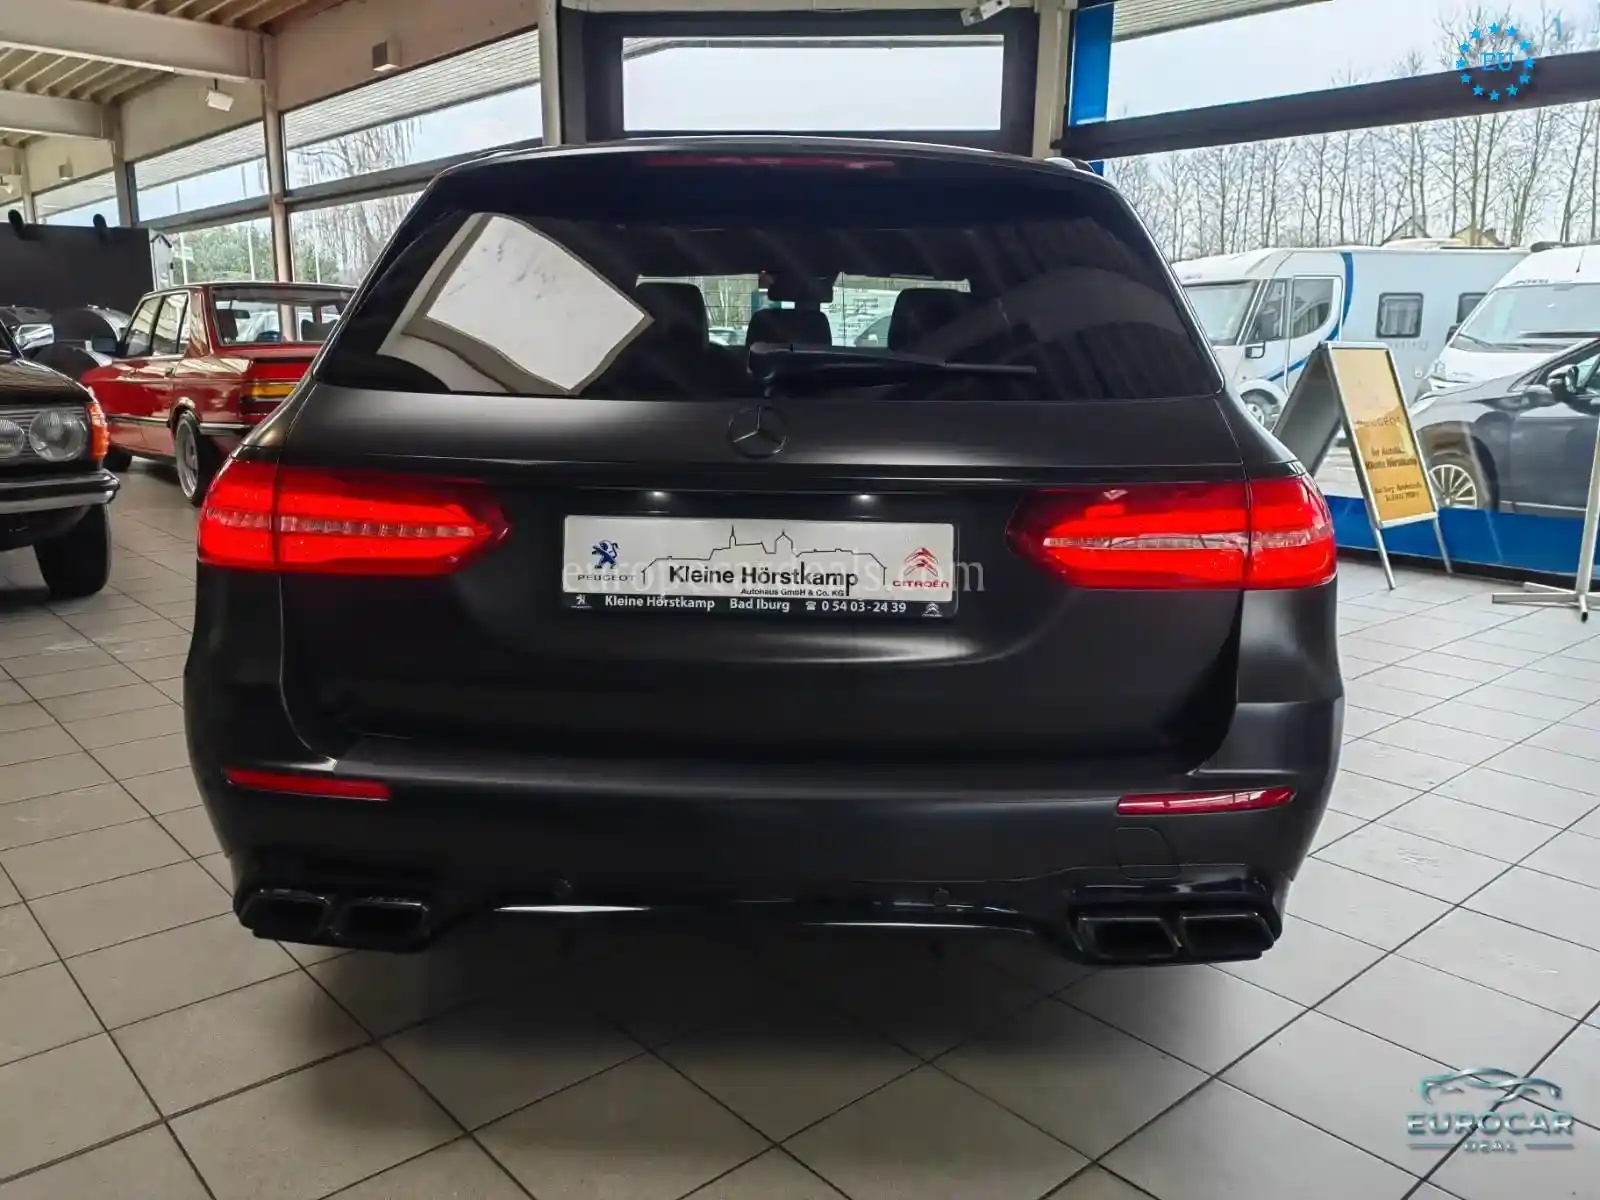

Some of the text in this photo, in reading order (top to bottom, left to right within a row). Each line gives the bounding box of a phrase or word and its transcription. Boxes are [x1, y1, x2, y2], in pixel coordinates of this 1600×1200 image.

[577, 574, 635, 582] PEUGEOT
[669, 562, 859, 597] Kleine Hörstkamp
[740, 588, 779, 596] Autohaus
[605, 595, 644, 608] Kleine
[647, 594, 716, 612] Hörstkamp
[729, 598, 754, 610] Bad
[756, 599, 790, 612] Iburg
[821, 600, 829, 611] 0
[832, 600, 847, 612] 54
[891, 601, 907, 613] 39
